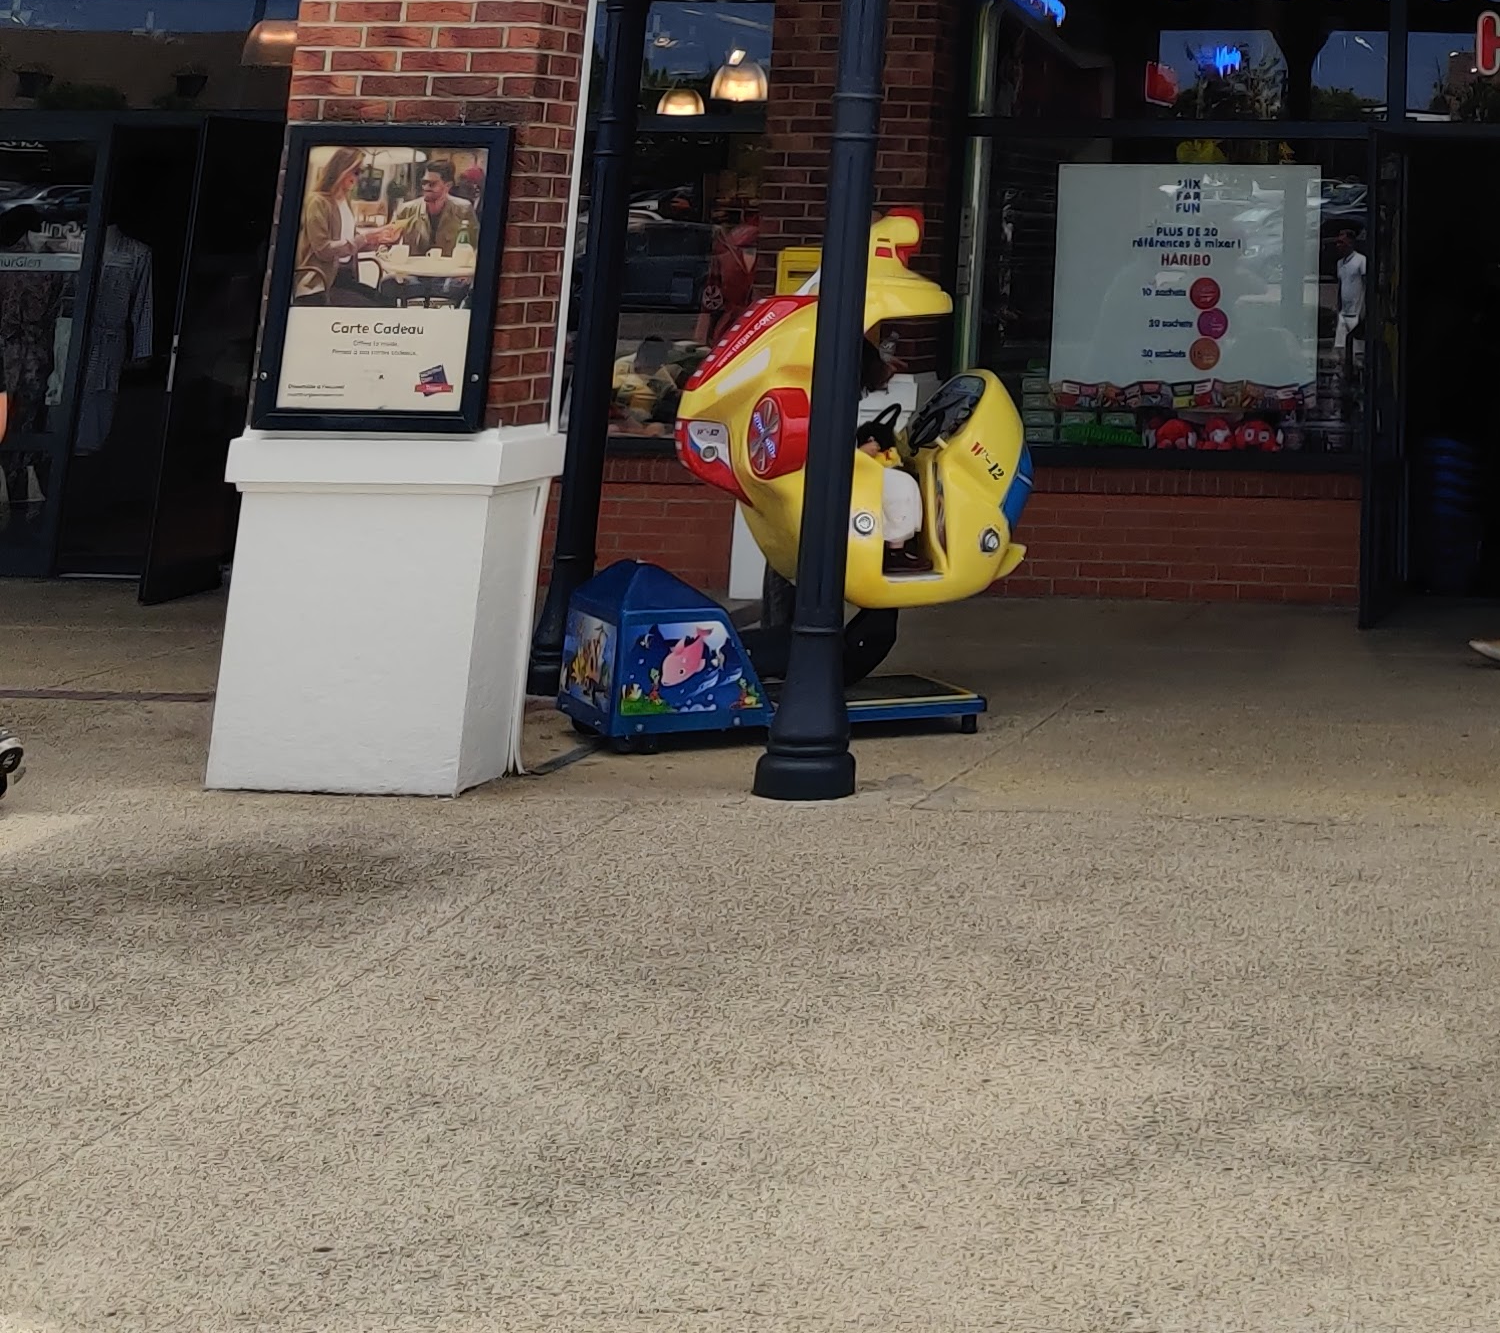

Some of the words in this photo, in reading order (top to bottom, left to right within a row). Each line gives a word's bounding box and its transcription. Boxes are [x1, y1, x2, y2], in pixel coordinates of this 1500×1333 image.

[1176, 203, 1201, 214] FUN
[1156, 227, 1183, 237] PLUS
[1187, 227, 1200, 236] DE
[1161, 253, 1211, 266] HARIBO
[331, 321, 370, 335] Carte
[373, 322, 425, 335] Cadeau
